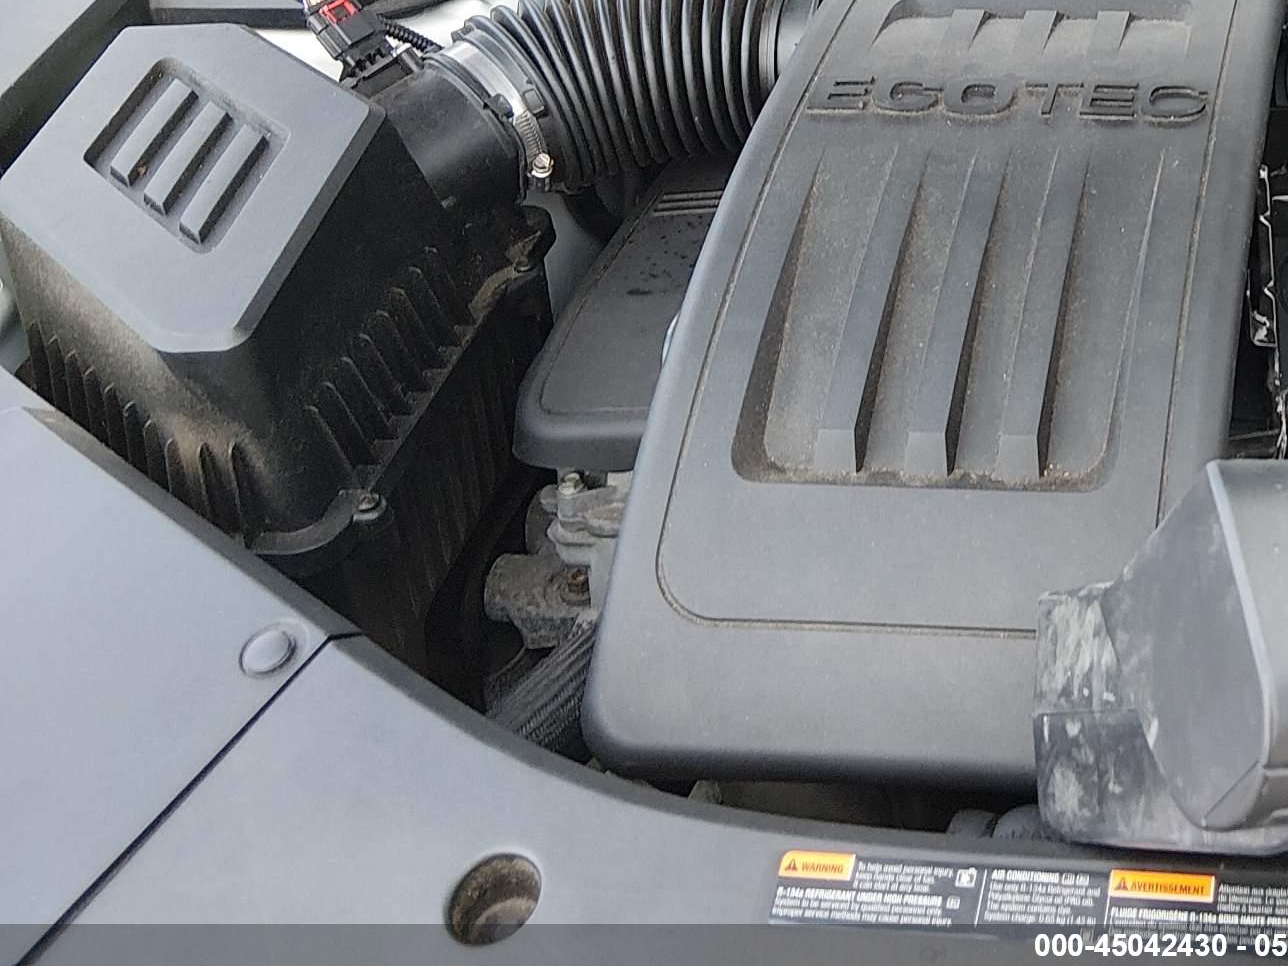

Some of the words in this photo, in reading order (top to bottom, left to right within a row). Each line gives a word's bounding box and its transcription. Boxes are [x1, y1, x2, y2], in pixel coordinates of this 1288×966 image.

[806, 77, 1209, 119] ECOTEC
[801, 862, 844, 875] WARNING
[991, 869, 1006, 880] AIR
[1006, 870, 1060, 883] CONDITIONING
[776, 886, 804, 898] R-134a
[804, 887, 857, 901] REFRIGERANT
[856, 891, 882, 903] UNDER
[883, 893, 903, 904] HIGH
[903, 894, 942, 906] PRESSURE
[1131, 881, 1205, 895] AVERTISSEMENT
[1111, 906, 1138, 919] FLUIDE
[1239, 915, 1267, 926] HAUTE
